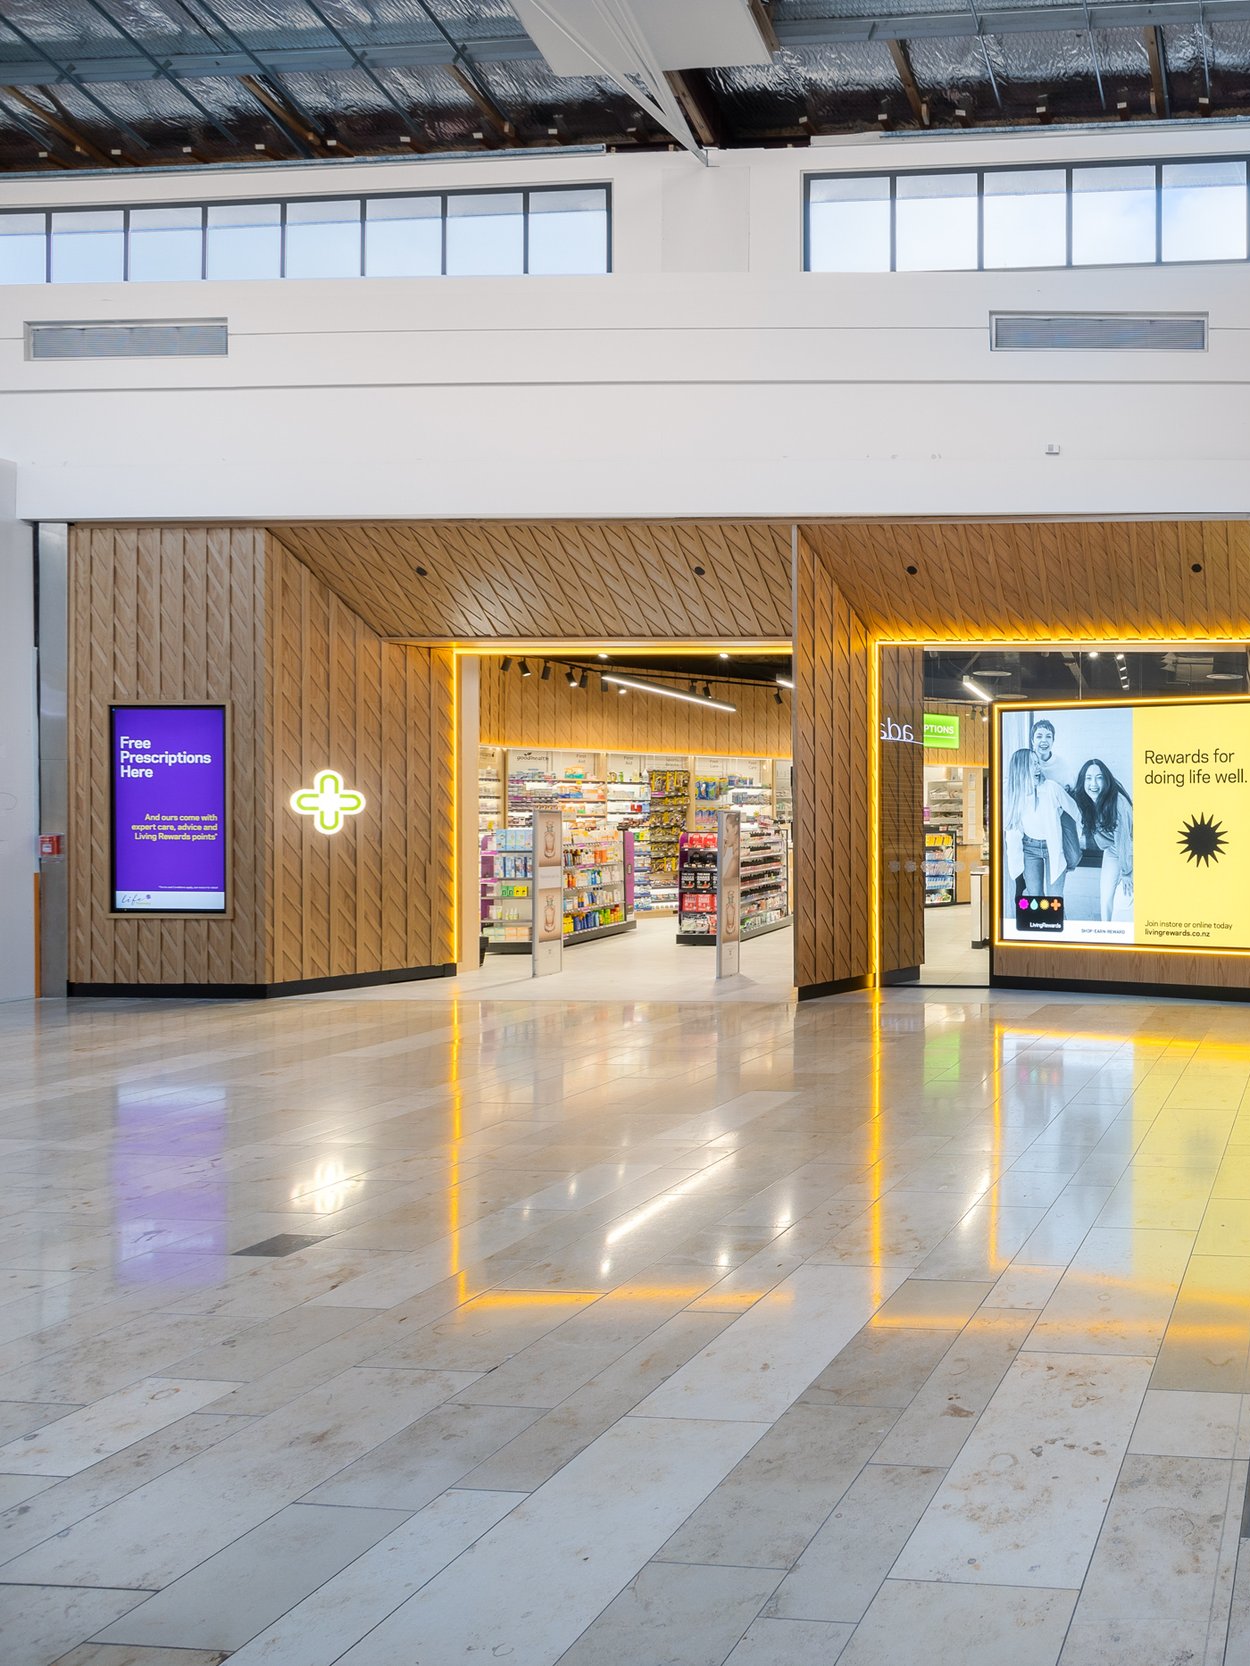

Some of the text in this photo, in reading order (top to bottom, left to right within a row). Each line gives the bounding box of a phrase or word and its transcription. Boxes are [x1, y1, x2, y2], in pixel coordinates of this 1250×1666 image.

[120, 736, 152, 749] Free
[120, 750, 213, 767] Prescriptions
[1144, 748, 1235, 764] Rewards for
[120, 765, 154, 778] Here
[1144, 768, 1248, 788] doing life well.
[145, 813, 160, 821] And
[134, 833, 157, 841] Living
[1144, 920, 1159, 928] Join
[1159, 920, 1183, 928] instore
[1214, 922, 1233, 930] today
[1144, 928, 1210, 938] livingrewards.co.nz
